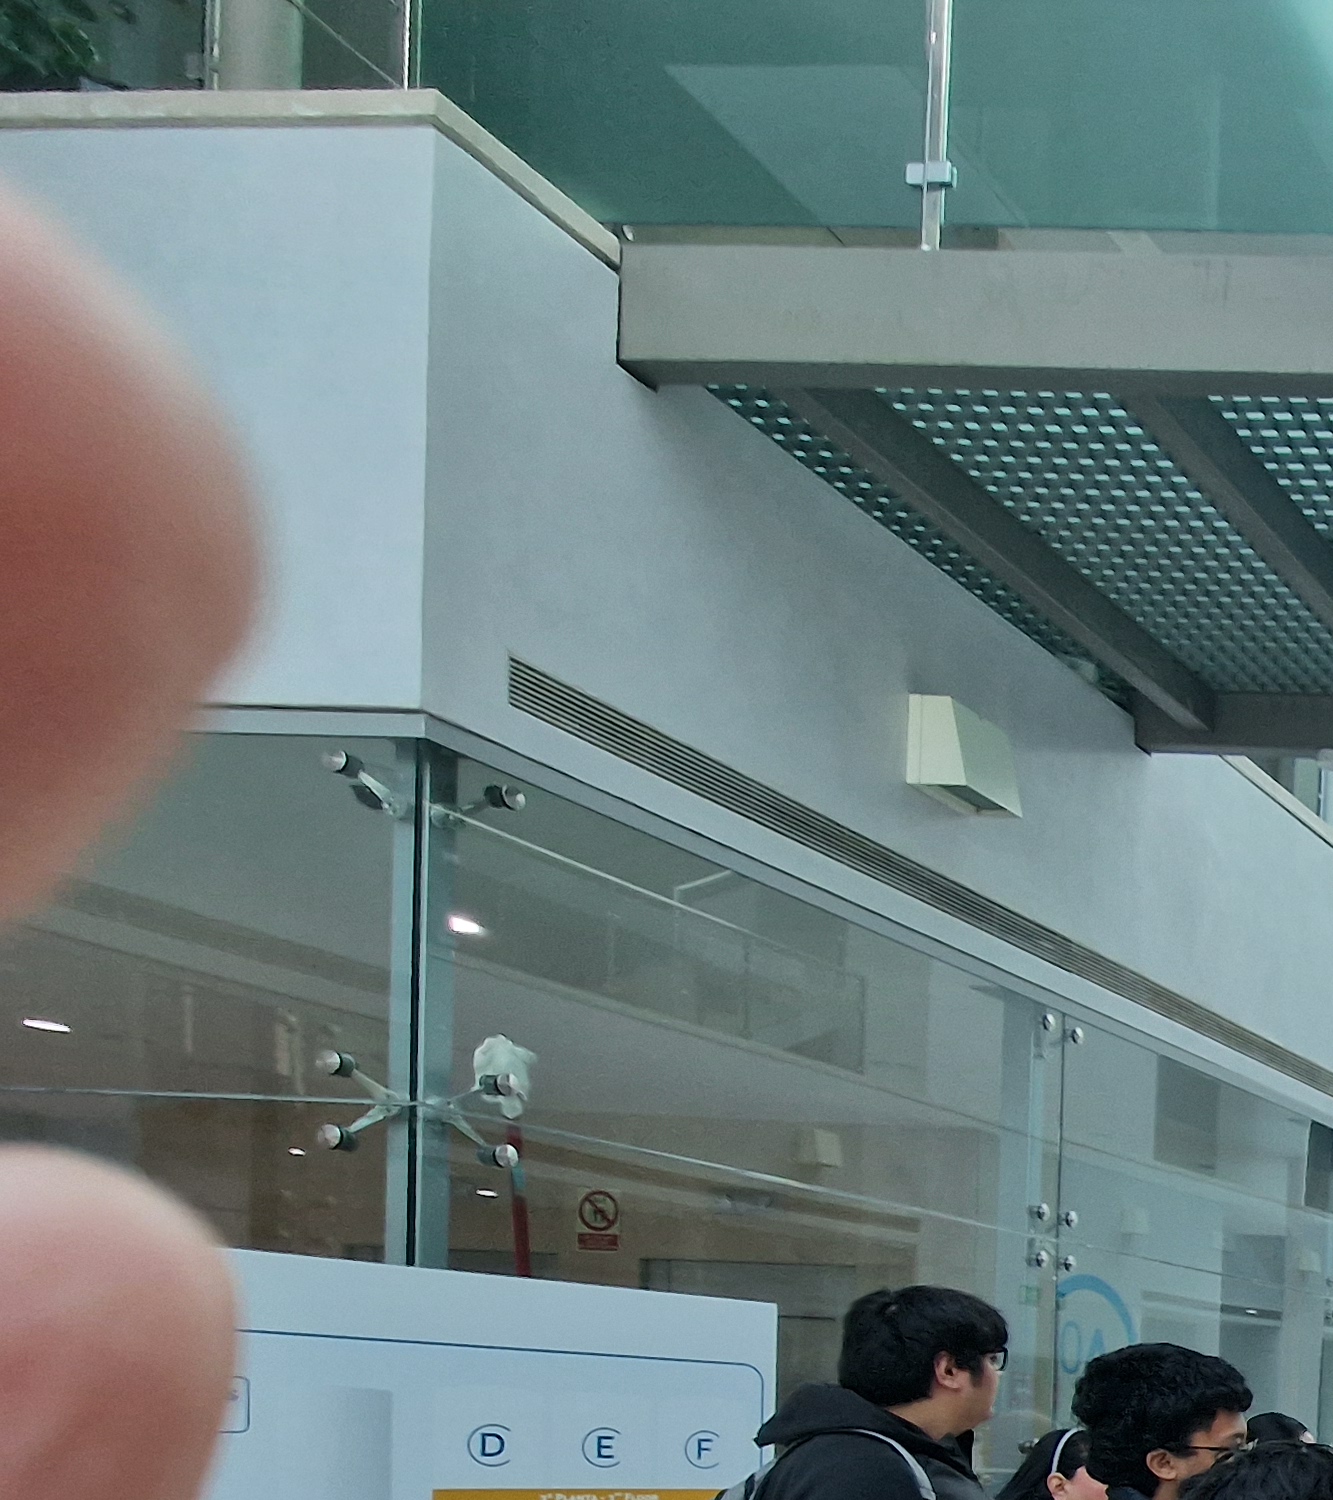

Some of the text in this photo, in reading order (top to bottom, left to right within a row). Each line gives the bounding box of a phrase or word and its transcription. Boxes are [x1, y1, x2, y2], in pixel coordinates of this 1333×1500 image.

[480, 1432, 506, 1458] D
[596, 1435, 615, 1459] E
[696, 1438, 714, 1460] F
